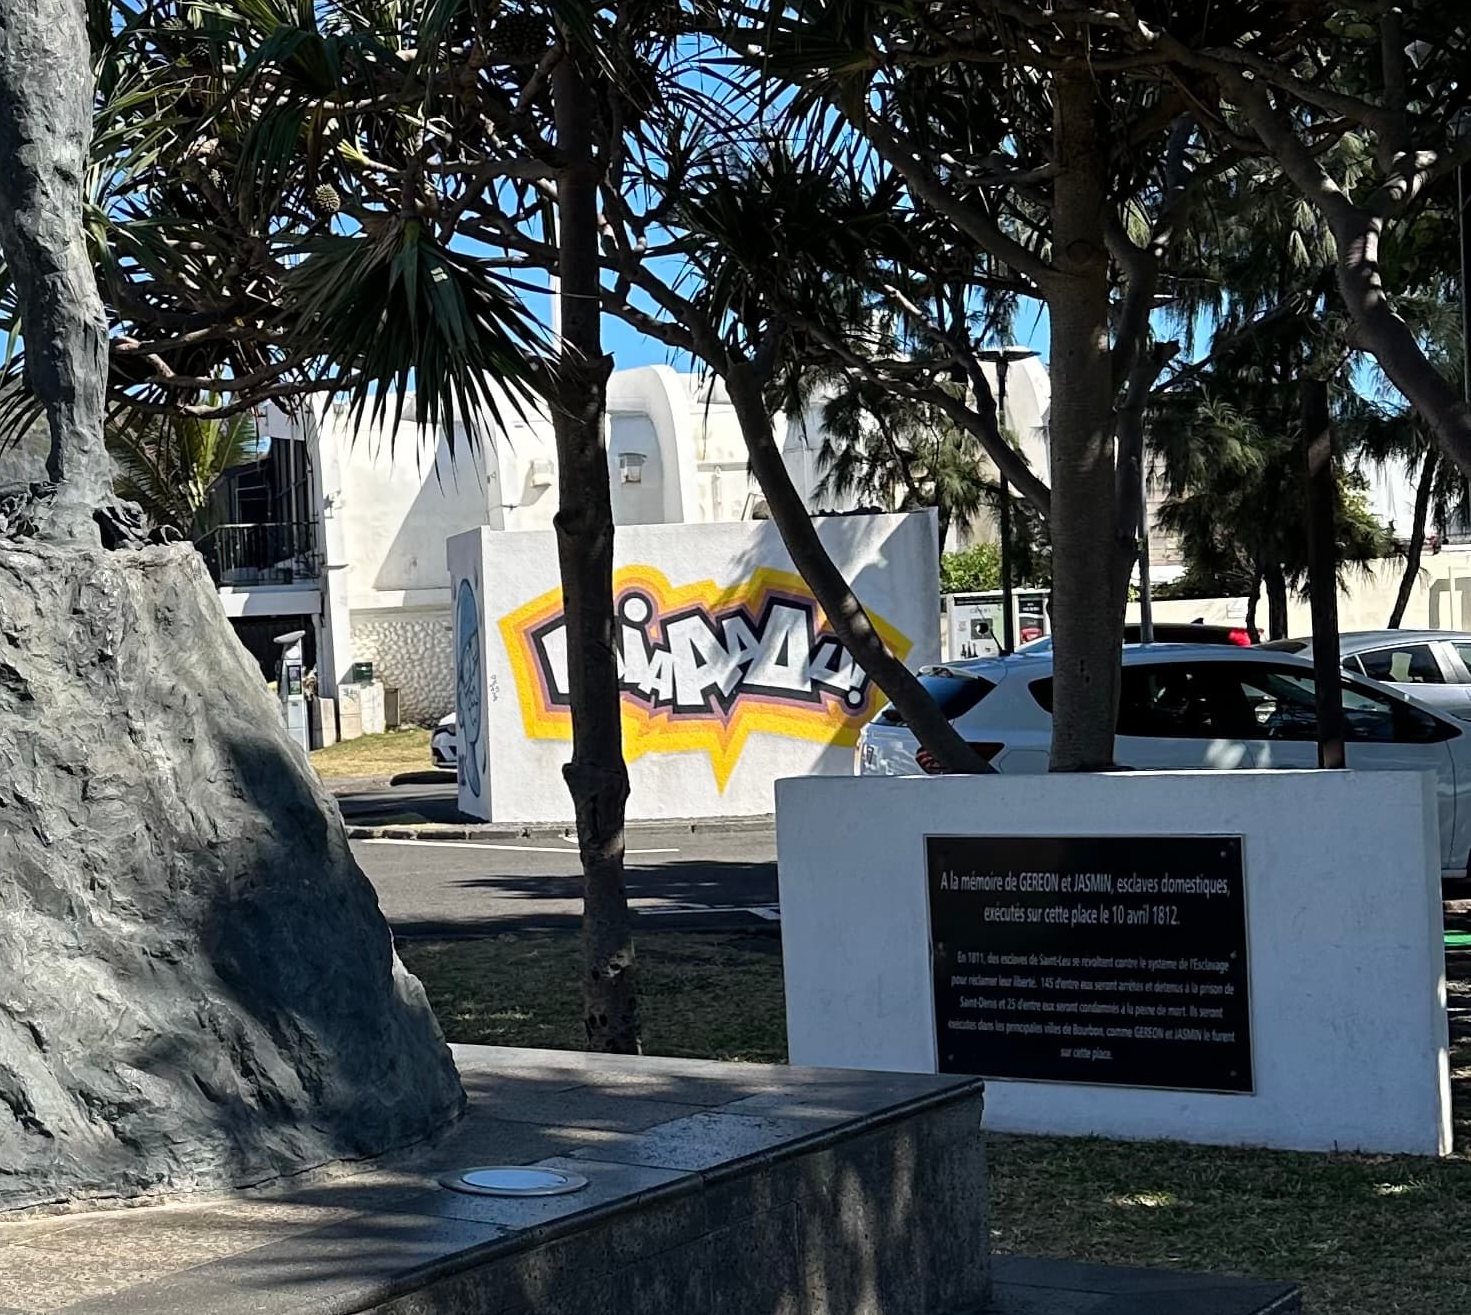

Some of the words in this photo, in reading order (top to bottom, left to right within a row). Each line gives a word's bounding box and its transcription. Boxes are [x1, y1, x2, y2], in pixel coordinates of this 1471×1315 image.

[940, 872, 948, 890] A
[950, 870, 959, 890] la
[961, 871, 1002, 890] mémoire
[1004, 870, 1017, 891] de
[1020, 873, 1059, 892] GEREON
[1061, 875, 1071, 892] et
[1073, 873, 1114, 894] JASMIN,
[1117, 872, 1158, 893] esclaves
[1160, 873, 1230, 899] domestiques,
[984, 902, 1025, 922] exécutés
[1027, 908, 1042, 922] sur
[1044, 905, 1069, 923] cette
[1070, 903, 1098, 928] place
[1100, 904, 1109, 924] le
[1112, 905, 1125, 924] 10
[1126, 904, 1150, 924] avril
[1152, 905, 1180, 924] 1812.
